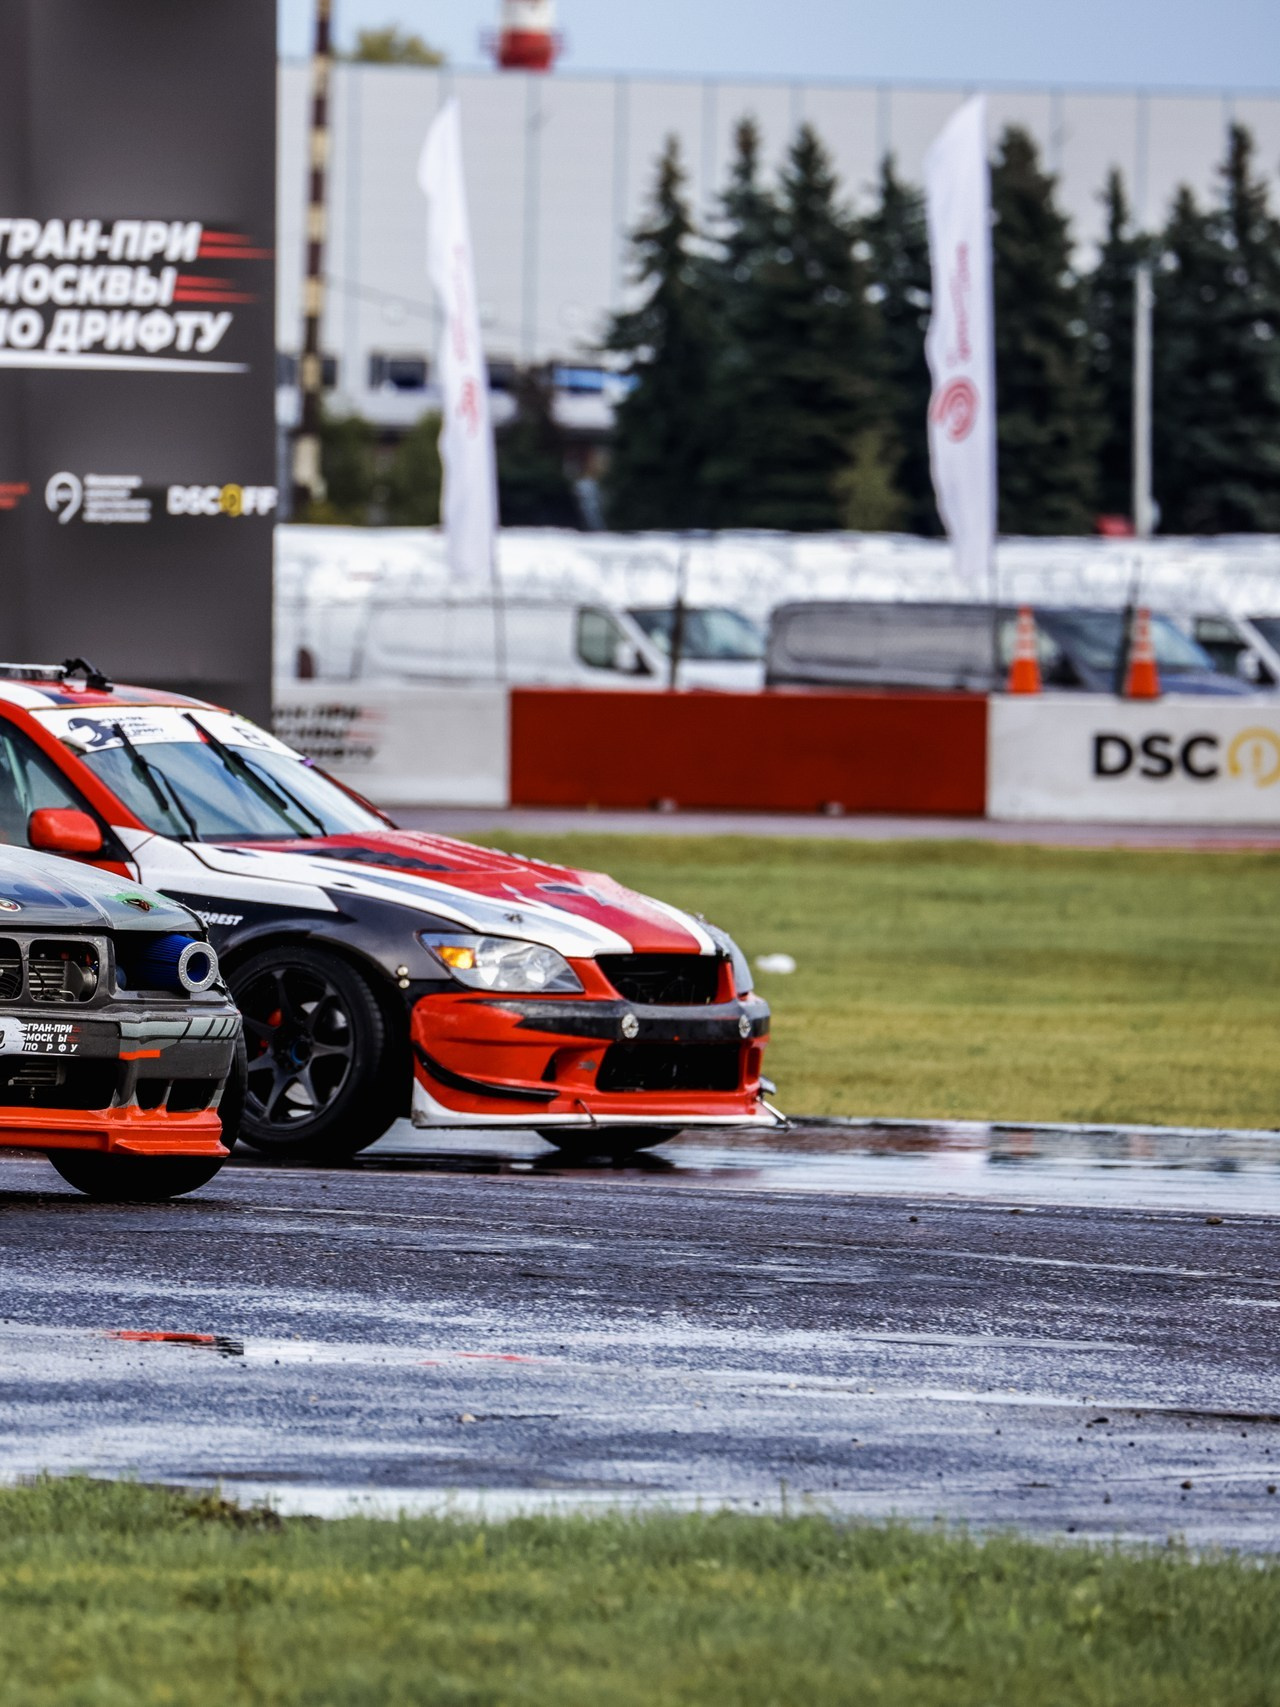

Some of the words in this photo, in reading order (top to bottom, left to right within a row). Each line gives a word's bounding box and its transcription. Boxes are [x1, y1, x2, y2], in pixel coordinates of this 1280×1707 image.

[45, 309, 233, 354] ДРИФТУ
[27, 1023, 73, 1033] ГРАН-ПРИ
[24, 1042, 39, 1051] ПО
